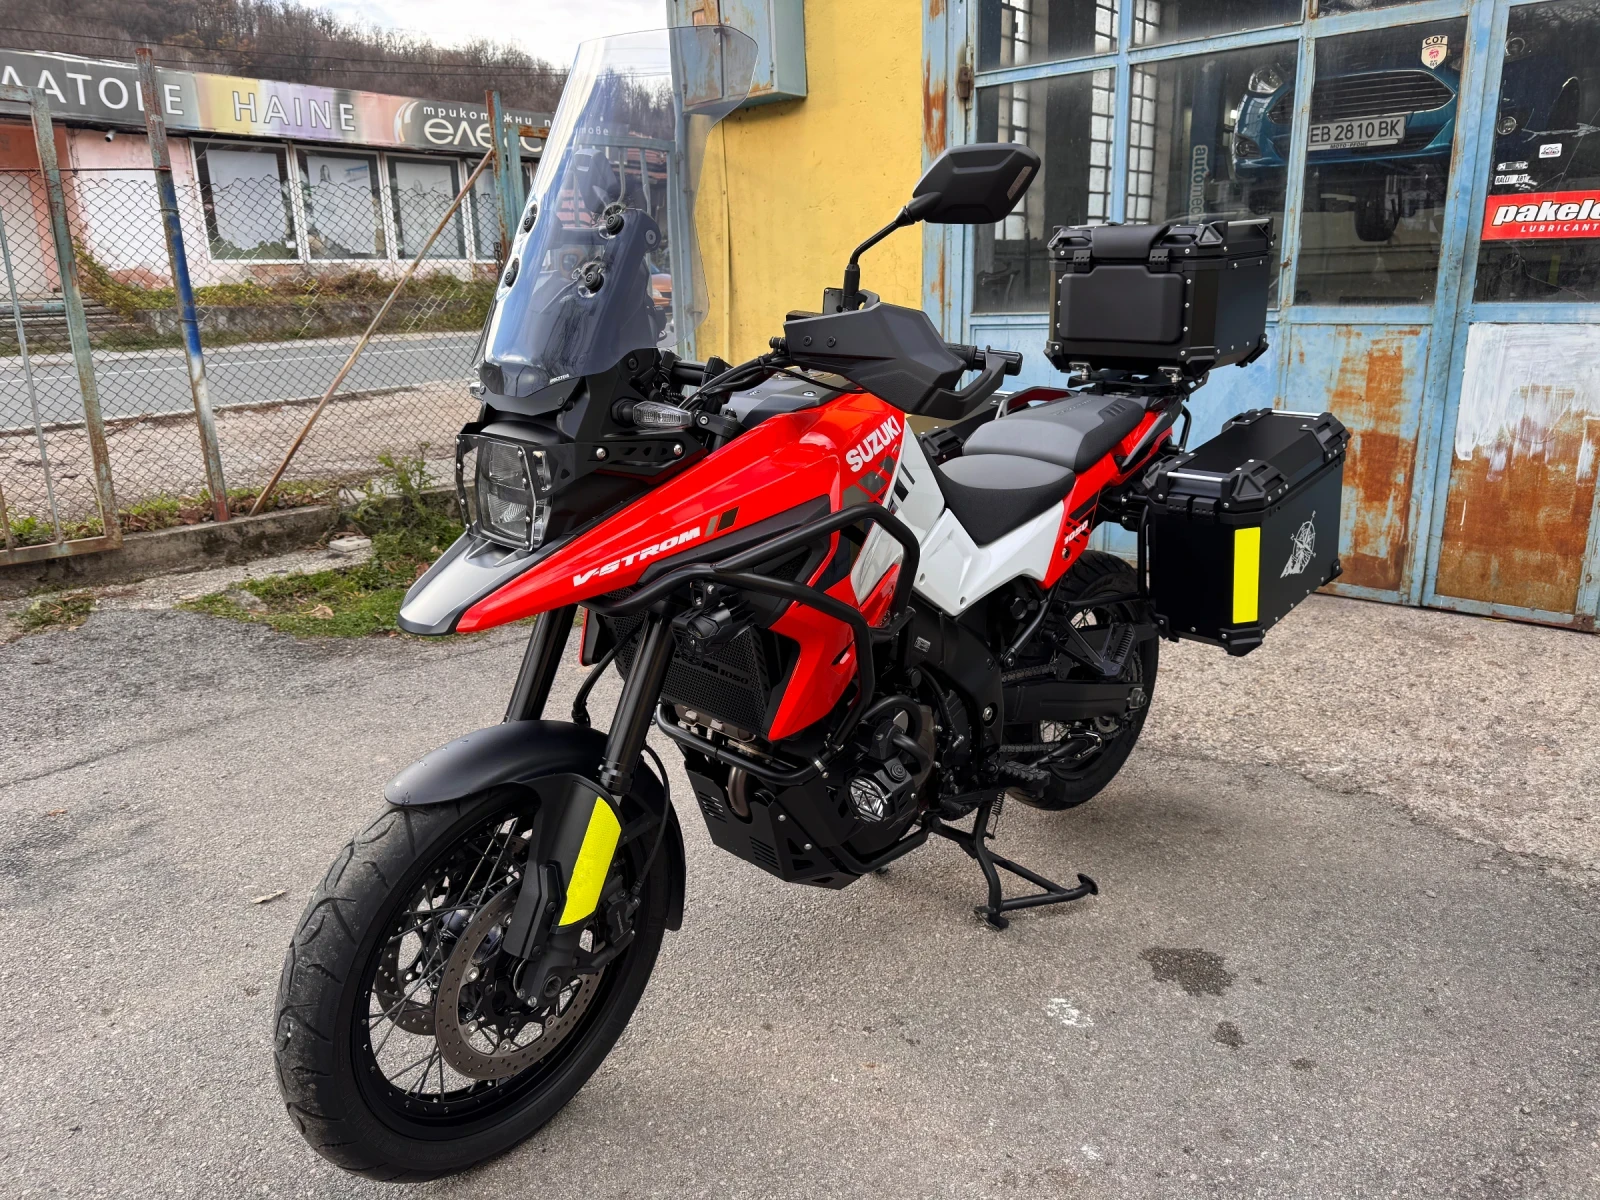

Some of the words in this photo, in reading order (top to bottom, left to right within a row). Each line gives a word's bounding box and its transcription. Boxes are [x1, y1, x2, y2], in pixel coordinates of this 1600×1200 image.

[232, 91, 355, 131] HAINE
[423, 105, 532, 125] трикотжни
[1310, 126, 1331, 143] EB
[1334, 122, 1375, 141] 2810
[1378, 119, 1401, 137] BK
[846, 415, 902, 472] SUZUKI
[1063, 520, 1089, 545] 1050
[573, 526, 700, 587] V-STROM
